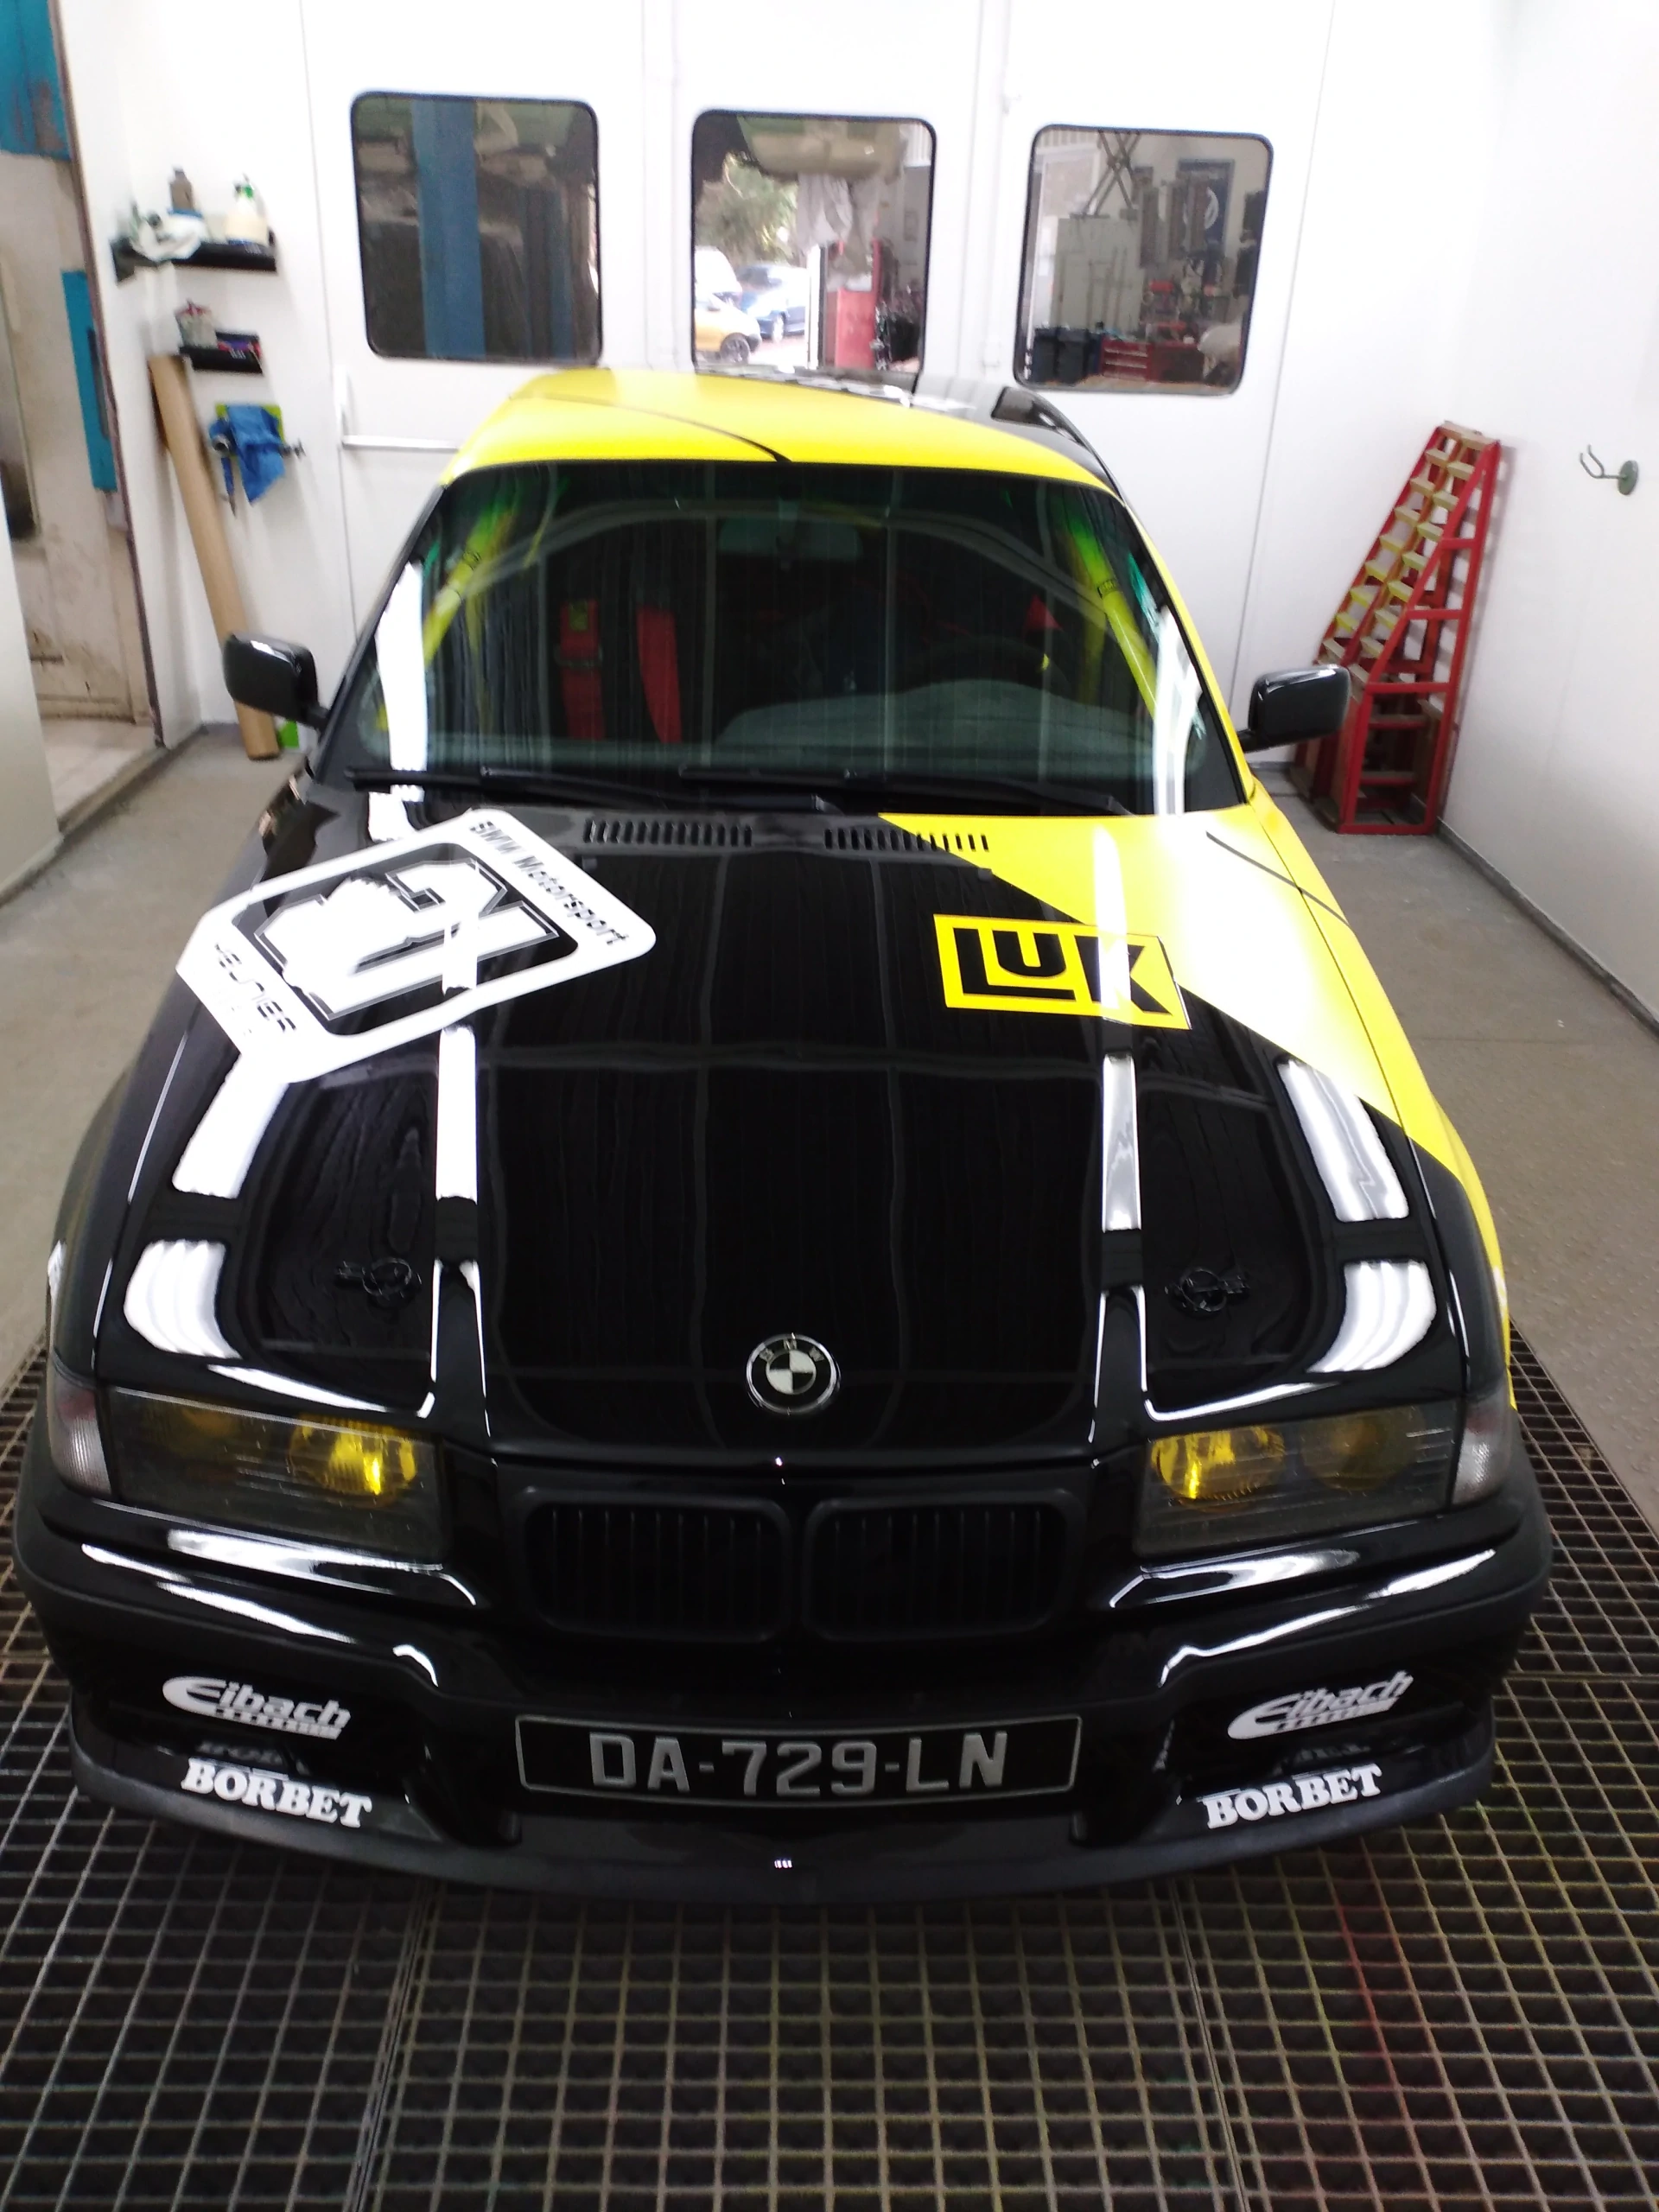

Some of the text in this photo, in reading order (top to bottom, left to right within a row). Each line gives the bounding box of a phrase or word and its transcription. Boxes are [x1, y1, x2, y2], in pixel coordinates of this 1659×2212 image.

[468, 820, 630, 946] BMW Motorsport
[162, 1675, 352, 1740] Eibach
[1227, 1669, 1414, 1740] Eibach
[181, 1758, 373, 1828] BORBET
[588, 1731, 1007, 1796] DA-729-LN
[1202, 1763, 1382, 1830] BORBET
